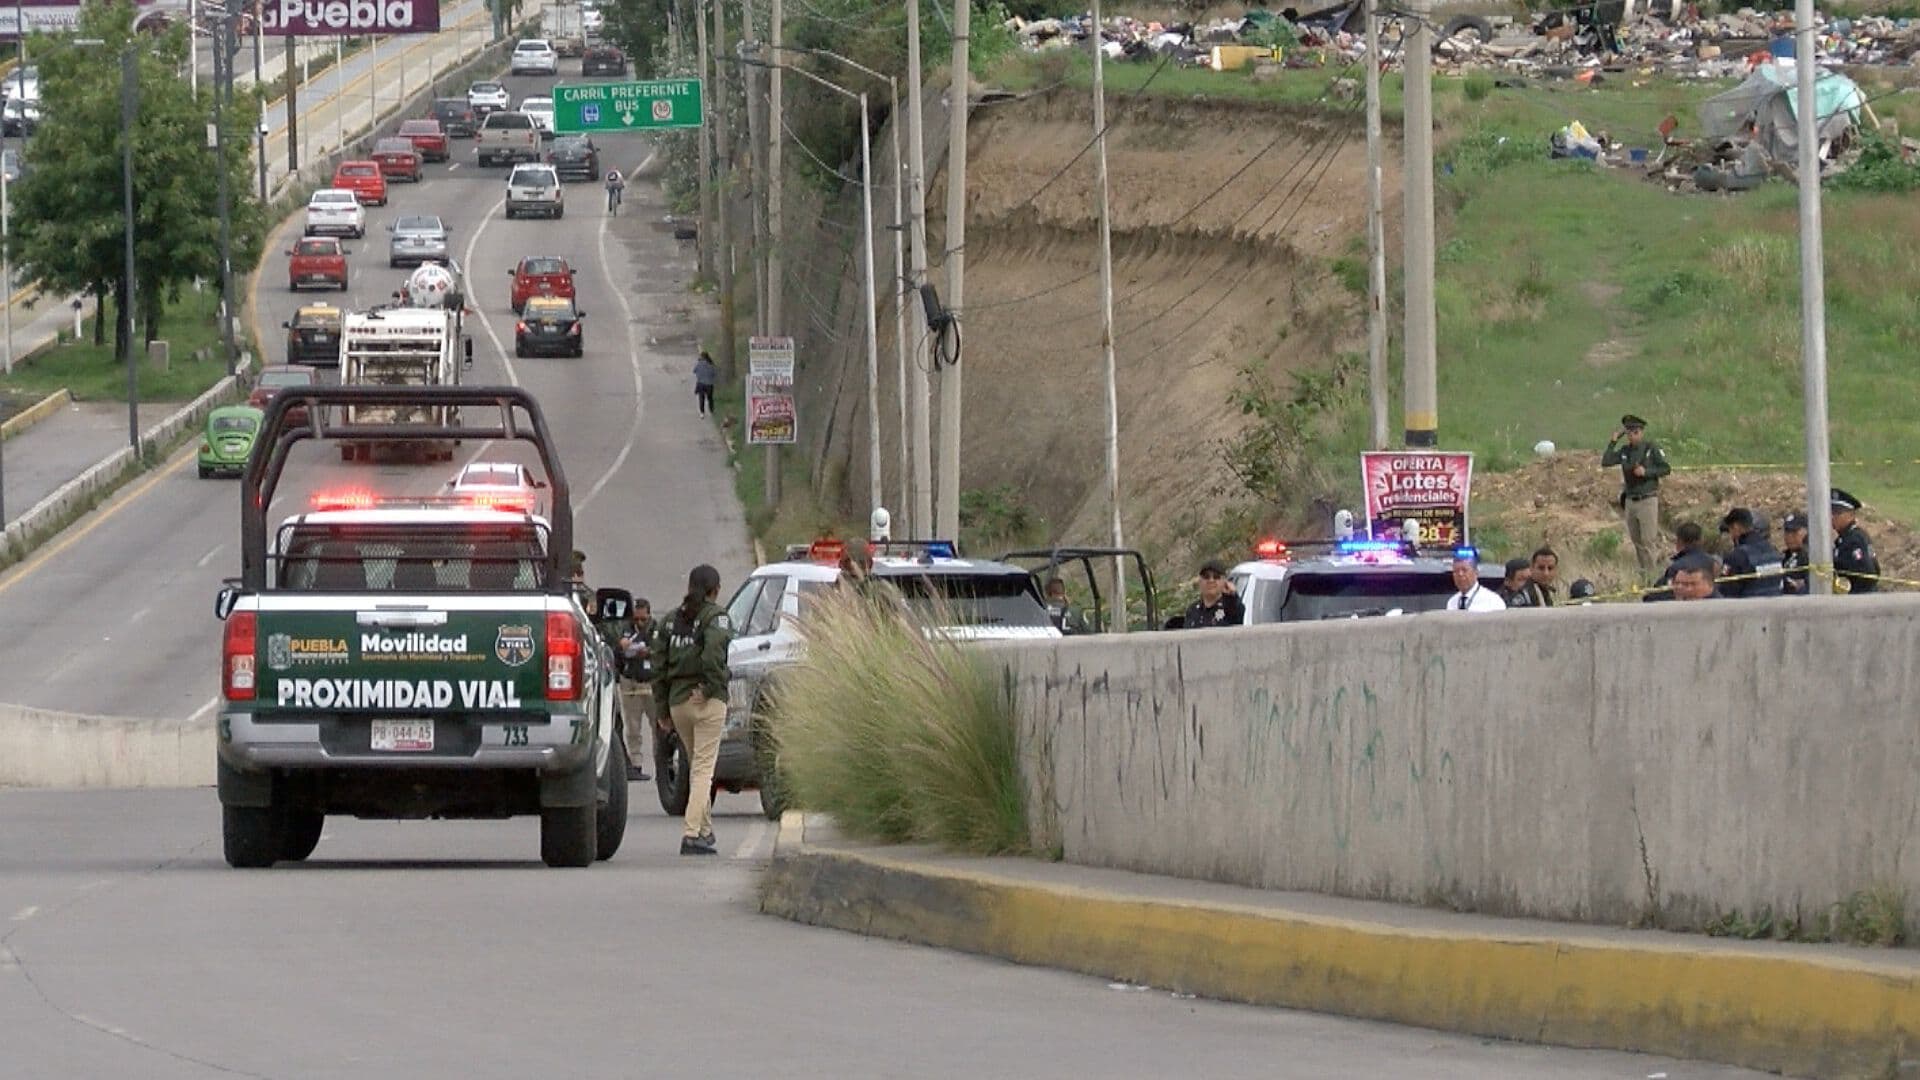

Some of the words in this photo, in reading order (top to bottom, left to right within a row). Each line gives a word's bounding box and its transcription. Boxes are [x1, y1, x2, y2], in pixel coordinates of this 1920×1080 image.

[280, 0, 413, 28] Puebla
[564, 88, 606, 101] CARRIL
[611, 83, 689, 99] PREFERENTE
[615, 100, 639, 112] BUS
[1393, 457, 1443, 471] OFERTA
[1391, 473, 1448, 491] Lotes
[1383, 490, 1455, 505] residenciales
[291, 638, 349, 652] PUEBLA
[361, 632, 468, 652] Movilidad
[277, 678, 453, 708] PROXIMIDAD
[458, 680, 521, 709] VIAL
[503, 724, 529, 746] 733
